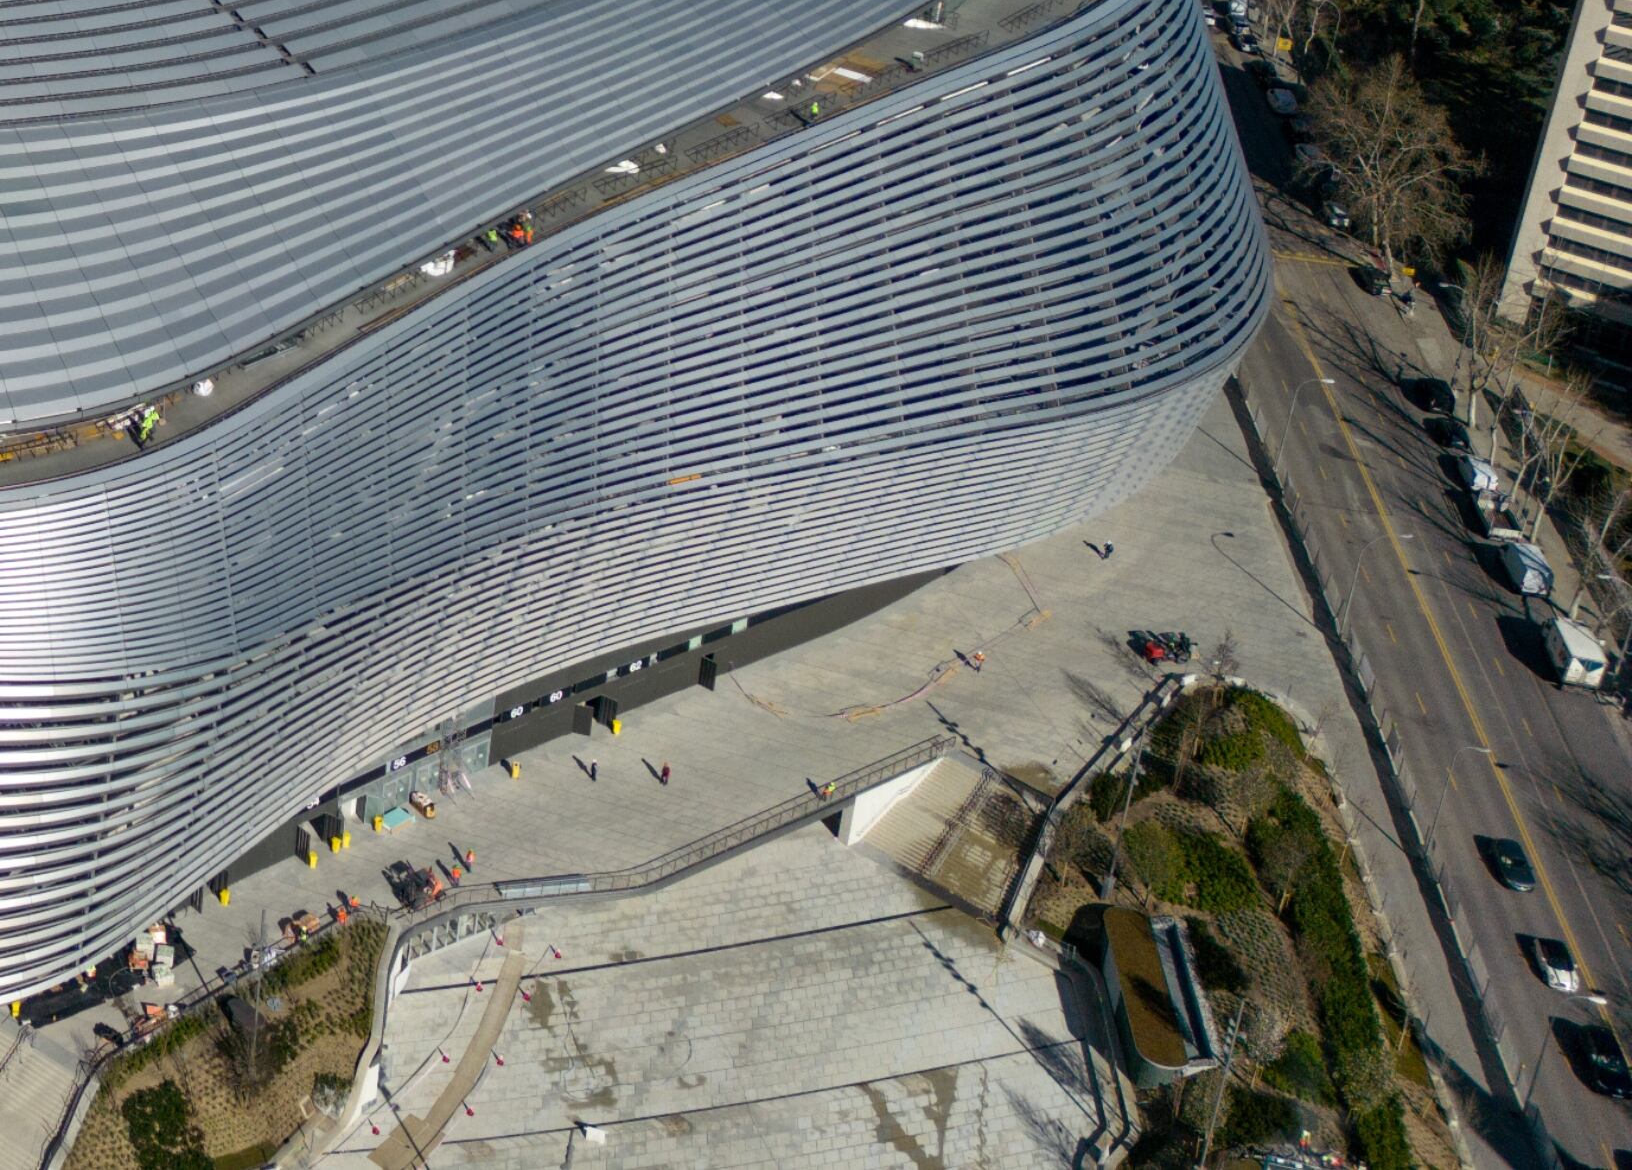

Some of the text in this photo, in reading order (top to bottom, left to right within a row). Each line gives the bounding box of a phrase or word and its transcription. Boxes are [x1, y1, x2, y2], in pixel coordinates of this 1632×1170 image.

[629, 660, 643, 673] 62
[550, 690, 563, 703] 60
[510, 706, 524, 718] 60
[393, 756, 407, 770] 56
